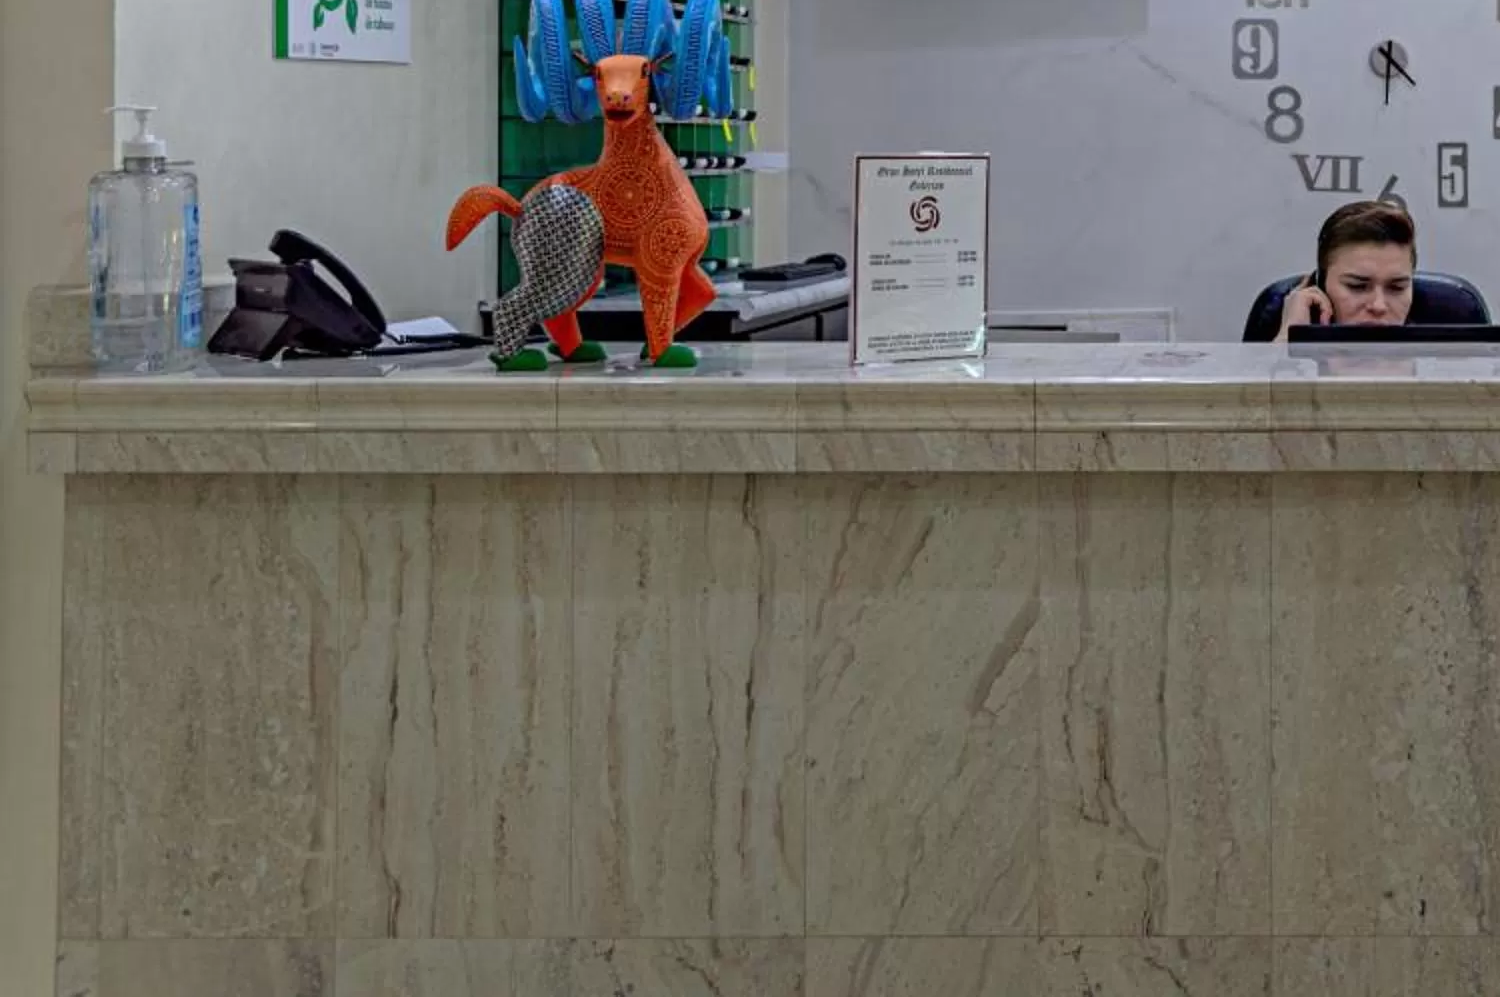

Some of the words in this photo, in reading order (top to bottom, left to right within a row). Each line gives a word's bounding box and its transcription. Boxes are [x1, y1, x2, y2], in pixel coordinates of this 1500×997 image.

[1236, 23, 1274, 75] 9
[1264, 85, 1304, 144] 8
[1290, 154, 1364, 193] VII
[1440, 145, 1465, 204] 5
